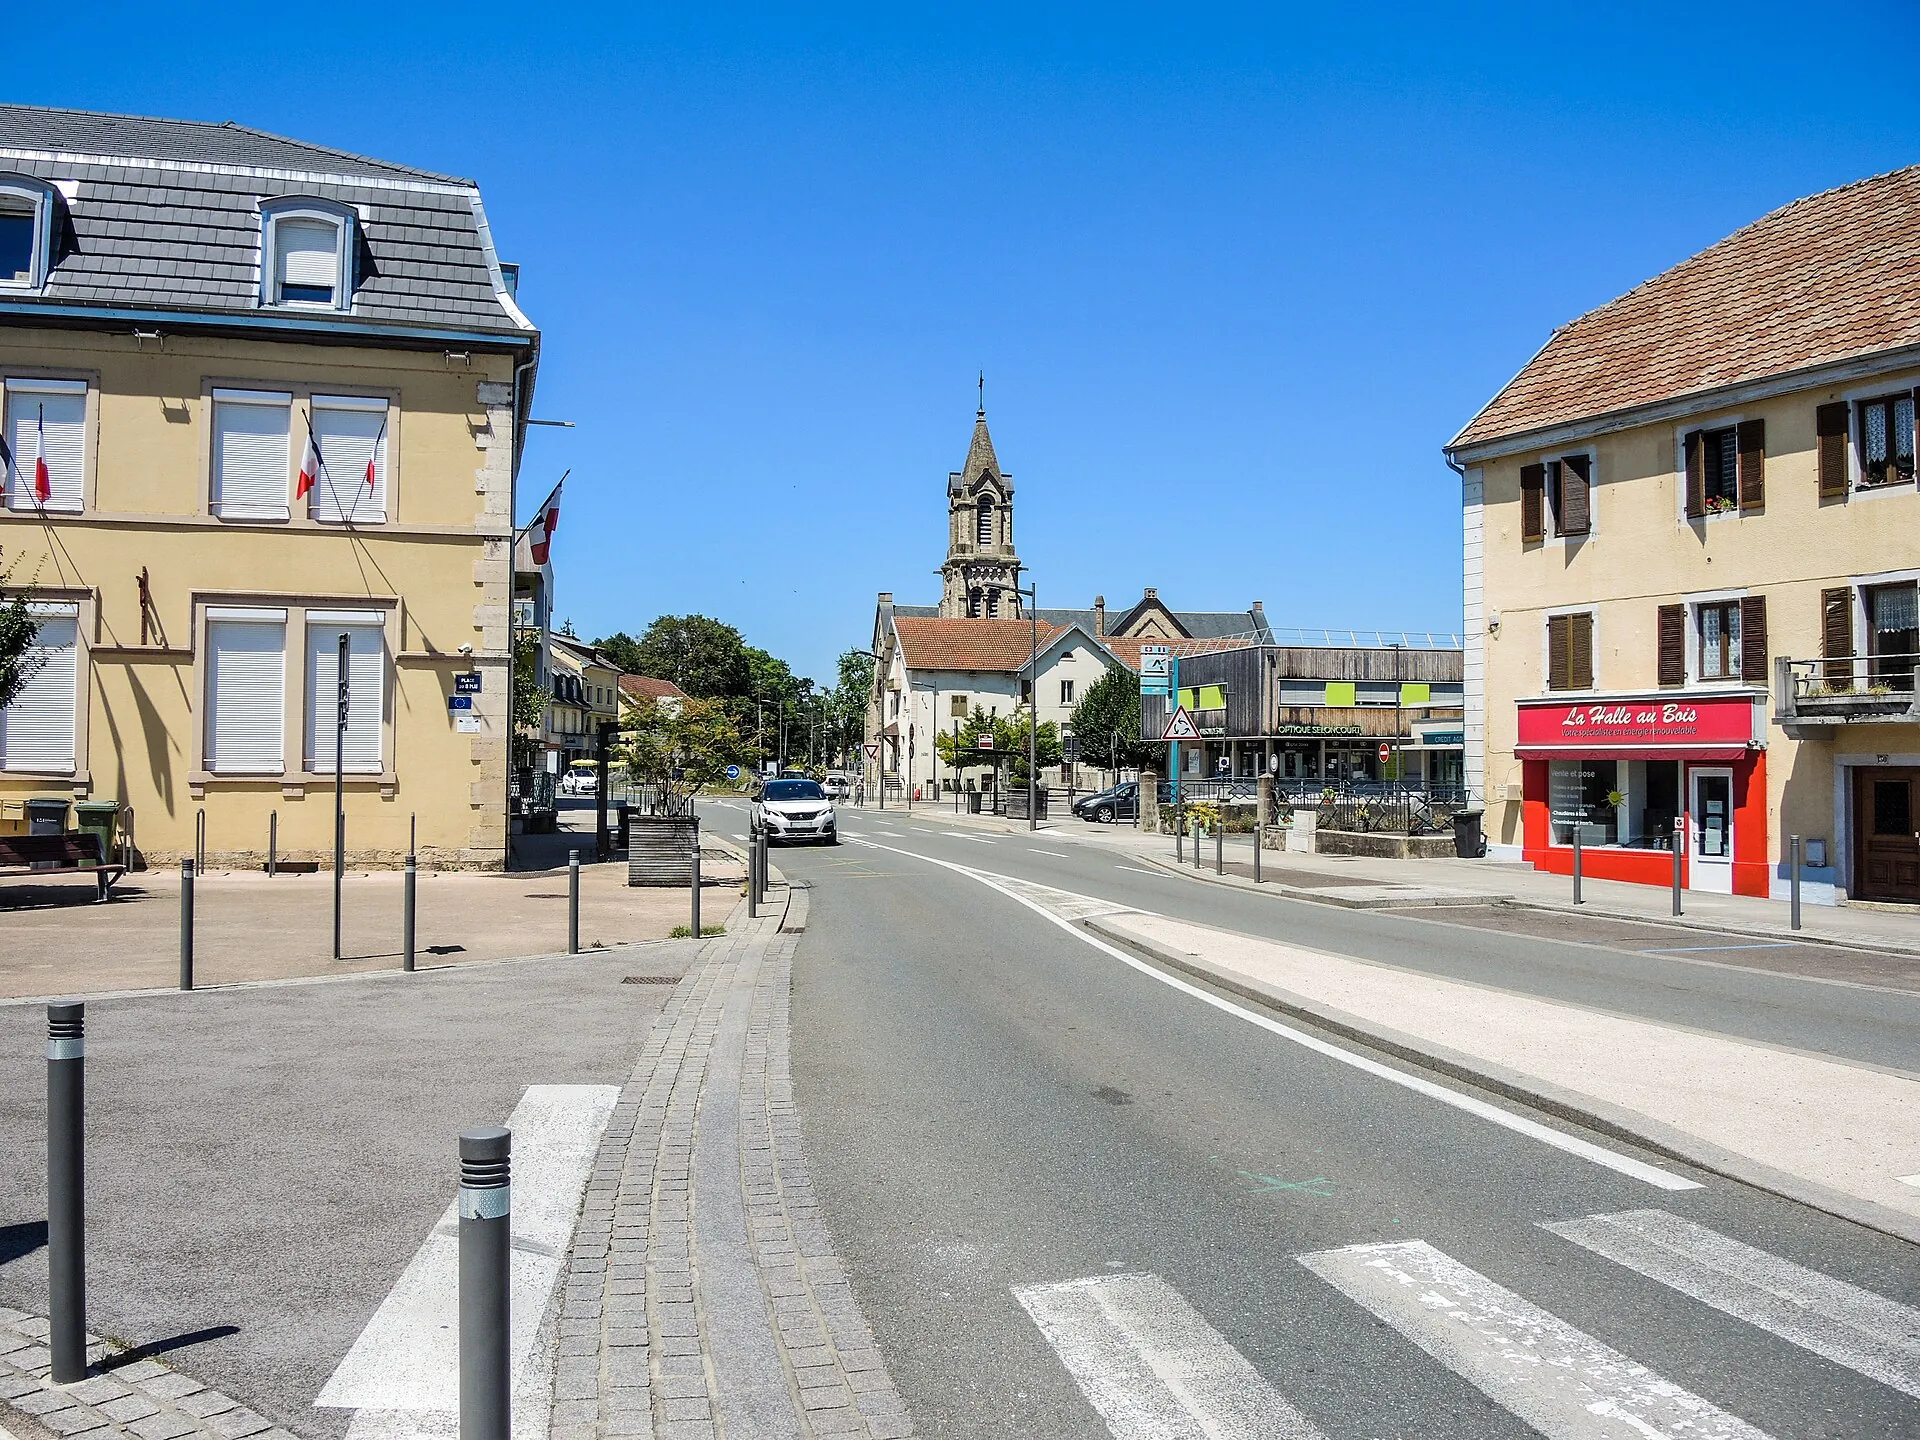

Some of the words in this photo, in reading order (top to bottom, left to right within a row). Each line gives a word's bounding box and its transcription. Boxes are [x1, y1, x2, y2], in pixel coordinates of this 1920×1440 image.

[1562, 706, 1585, 726] La
[1588, 705, 1632, 725] Halle
[1636, 711, 1657, 724] au
[1662, 703, 1698, 724] Bois
[1278, 726, 1311, 734] OPTIQUE
[1312, 726, 1362, 734] SELONCOURT
[1578, 771, 1596, 779] pose
